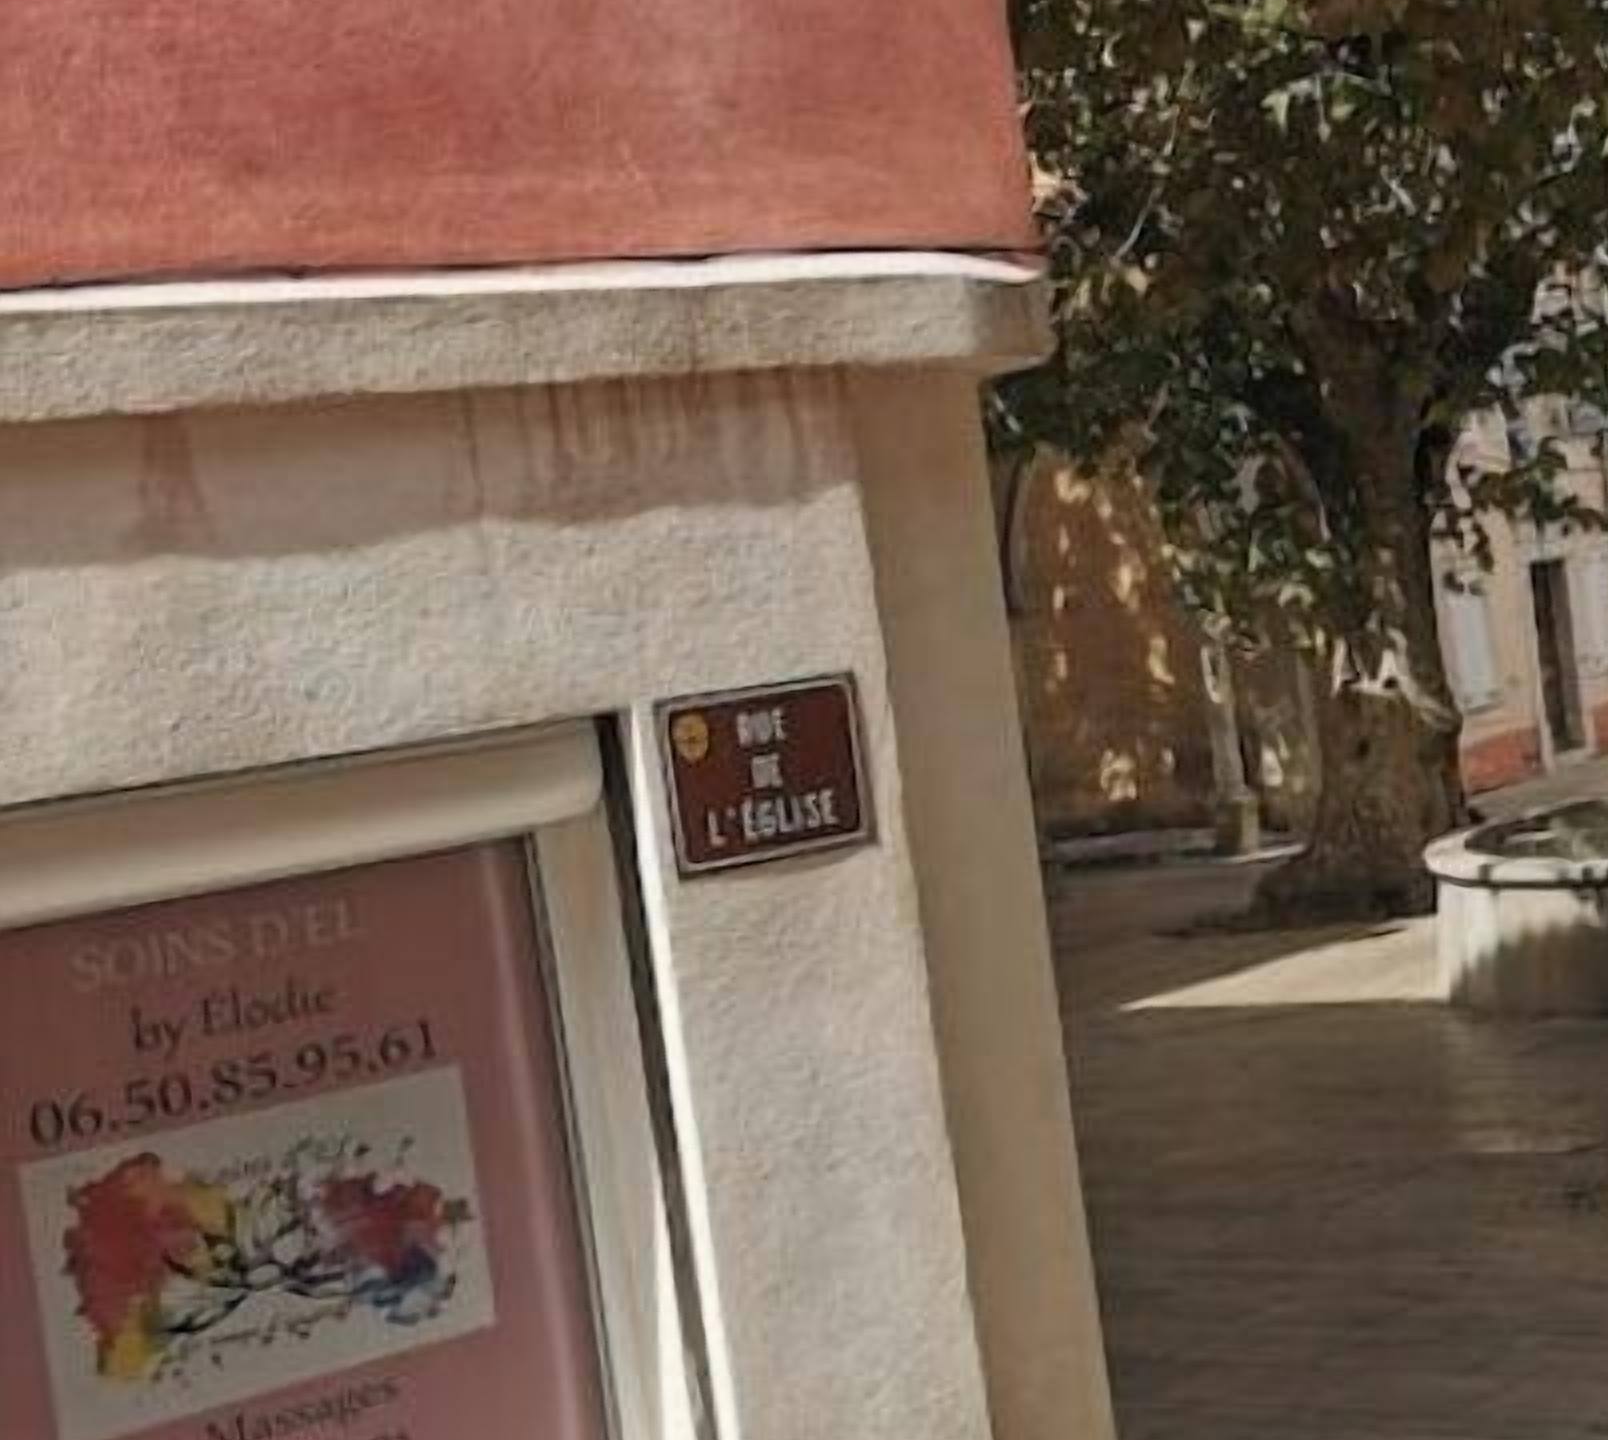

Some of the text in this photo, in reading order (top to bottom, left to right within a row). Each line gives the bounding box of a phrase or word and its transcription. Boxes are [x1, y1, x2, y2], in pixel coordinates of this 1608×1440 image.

[71, 920, 237, 992] SOINS
[132, 1006, 186, 1066] by
[29, 1020, 439, 1147] 06.50.85.95.61
